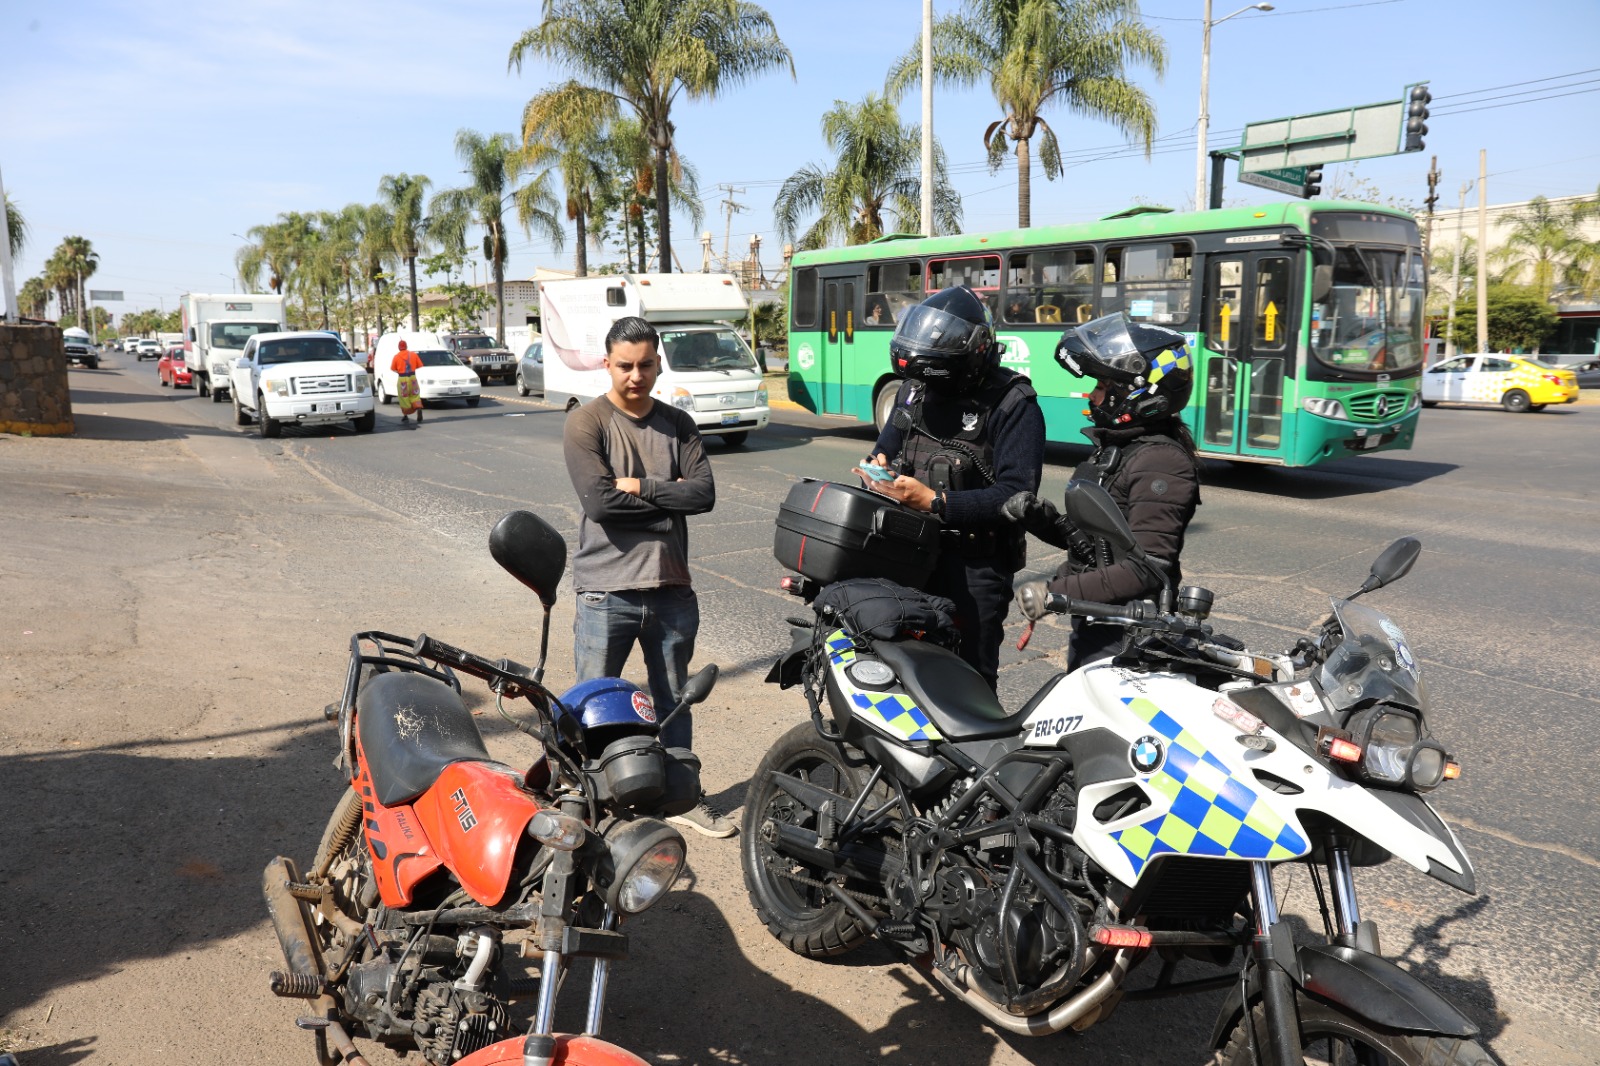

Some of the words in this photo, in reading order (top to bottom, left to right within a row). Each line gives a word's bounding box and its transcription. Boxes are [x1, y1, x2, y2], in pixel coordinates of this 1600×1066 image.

[1035, 714, 1083, 738] ERI-077
[1132, 736, 1160, 751] BMW
[394, 810, 414, 840] ITALIKA
